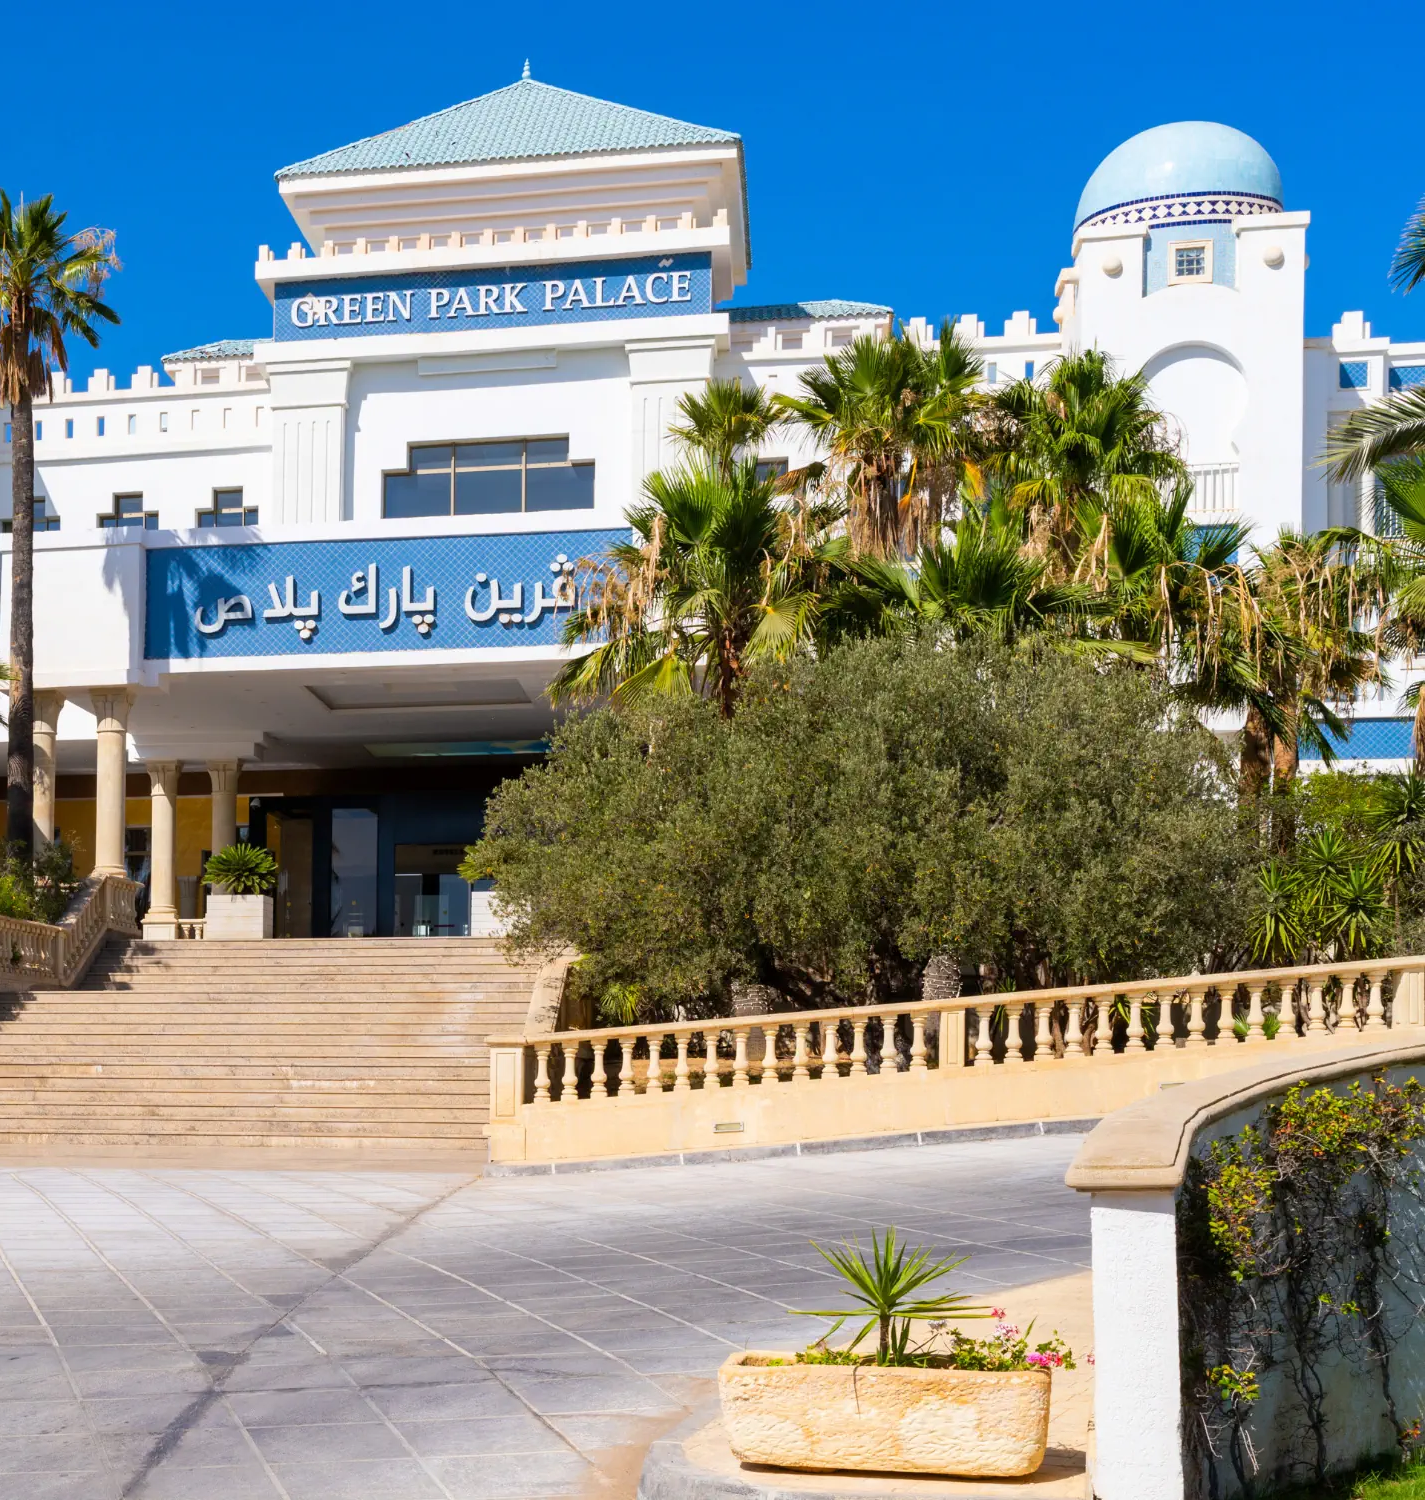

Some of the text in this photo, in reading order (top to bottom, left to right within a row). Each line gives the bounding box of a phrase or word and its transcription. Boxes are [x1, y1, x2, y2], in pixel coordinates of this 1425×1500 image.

[291, 271, 691, 328] GREEN PARK PALACE
